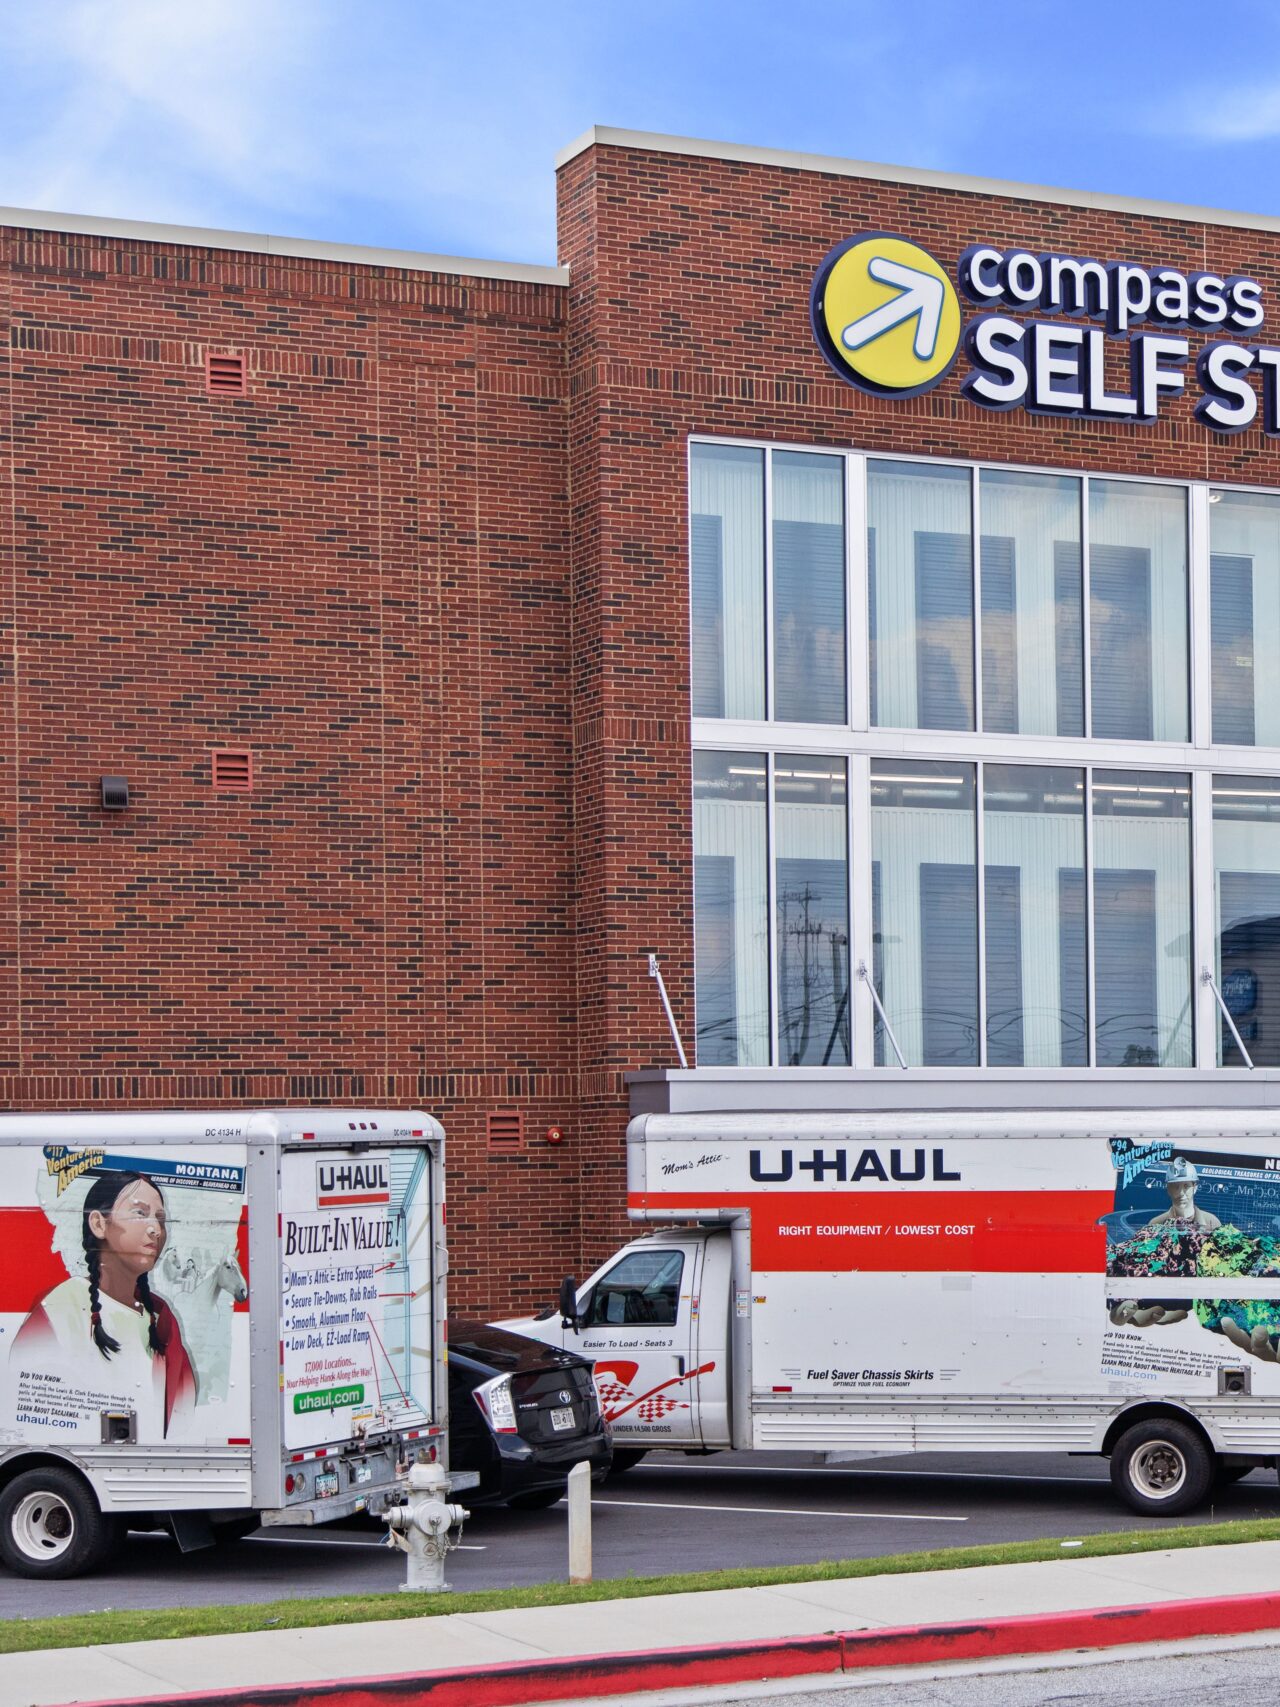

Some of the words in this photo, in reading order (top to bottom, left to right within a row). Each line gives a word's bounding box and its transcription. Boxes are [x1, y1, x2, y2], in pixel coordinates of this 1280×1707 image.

[969, 249, 1265, 331] compass
[972, 318, 1190, 416] SELF
[205, 1128, 216, 1136] DC
[217, 1128, 234, 1136] 4134
[235, 1128, 241, 1136] H
[47, 1151, 84, 1176] Venture
[662, 1161, 694, 1176] Mom's
[697, 1154, 723, 1168] Attic
[750, 1148, 961, 1182] U-HAUL
[1111, 1145, 1150, 1169] Venture
[57, 1155, 103, 1198] America
[176, 1164, 239, 1180] MONTANA
[320, 1164, 388, 1192] U-HAUL
[1123, 1150, 1171, 1190] America
[285, 1217, 350, 1256] BUILT-IN
[351, 1213, 400, 1251] VALUE!
[778, 1226, 812, 1236] RIGHT
[816, 1225, 882, 1236] EQUIPMENT
[895, 1225, 942, 1236] LOWEST
[944, 1225, 976, 1235] COST
[291, 1271, 313, 1287] Mom's
[314, 1270, 330, 1285] Attic
[337, 1268, 354, 1282] Extra
[355, 1265, 374, 1284] Space!
[291, 1294, 312, 1308] Secure
[314, 1290, 348, 1306] Tie-Downs,
[350, 1286, 361, 1302] Rub
[363, 1285, 378, 1300] Rails
[292, 1313, 318, 1330] Smooth,
[320, 1311, 350, 1326] Aluminum
[351, 1307, 366, 1322] Floor
[292, 1336, 306, 1351] Low
[307, 1332, 324, 1349] Deck,
[327, 1328, 352, 1346] EZ-Load
[353, 1329, 369, 1345] Ramp
[583, 1340, 607, 1348] Easier
[608, 1340, 617, 1348] To
[667, 1339, 673, 1347] 3
[1114, 1332, 1126, 1340] YOU
[20, 1371, 30, 1379] DID
[31, 1373, 43, 1381] YOU
[305, 1361, 323, 1373] 17,000
[807, 1369, 829, 1380] Fuel
[862, 1369, 901, 1380] Chassis
[904, 1369, 934, 1380] Skirts
[1100, 1367, 1157, 1381] uhaul.com
[1101, 1358, 1118, 1366] LEARN
[1118, 1360, 1133, 1368] MORE
[1133, 1362, 1151, 1370] ABOUT
[1151, 1364, 1169, 1373] MINING
[1170, 1366, 1194, 1376] HERITAGE
[286, 1379, 298, 1389] Your
[299, 1375, 319, 1389] Helping
[320, 1372, 335, 1383] Hands
[337, 1370, 351, 1382] Along
[351, 1368, 359, 1377] the
[17, 1403, 32, 1411] LEARN
[33, 1405, 50, 1414] ABOUT
[299, 1389, 360, 1411] uhaul.com
[16, 1413, 78, 1429] uhaul.com
[613, 1425, 634, 1433] UNDER
[652, 1425, 672, 1433] GROSS
